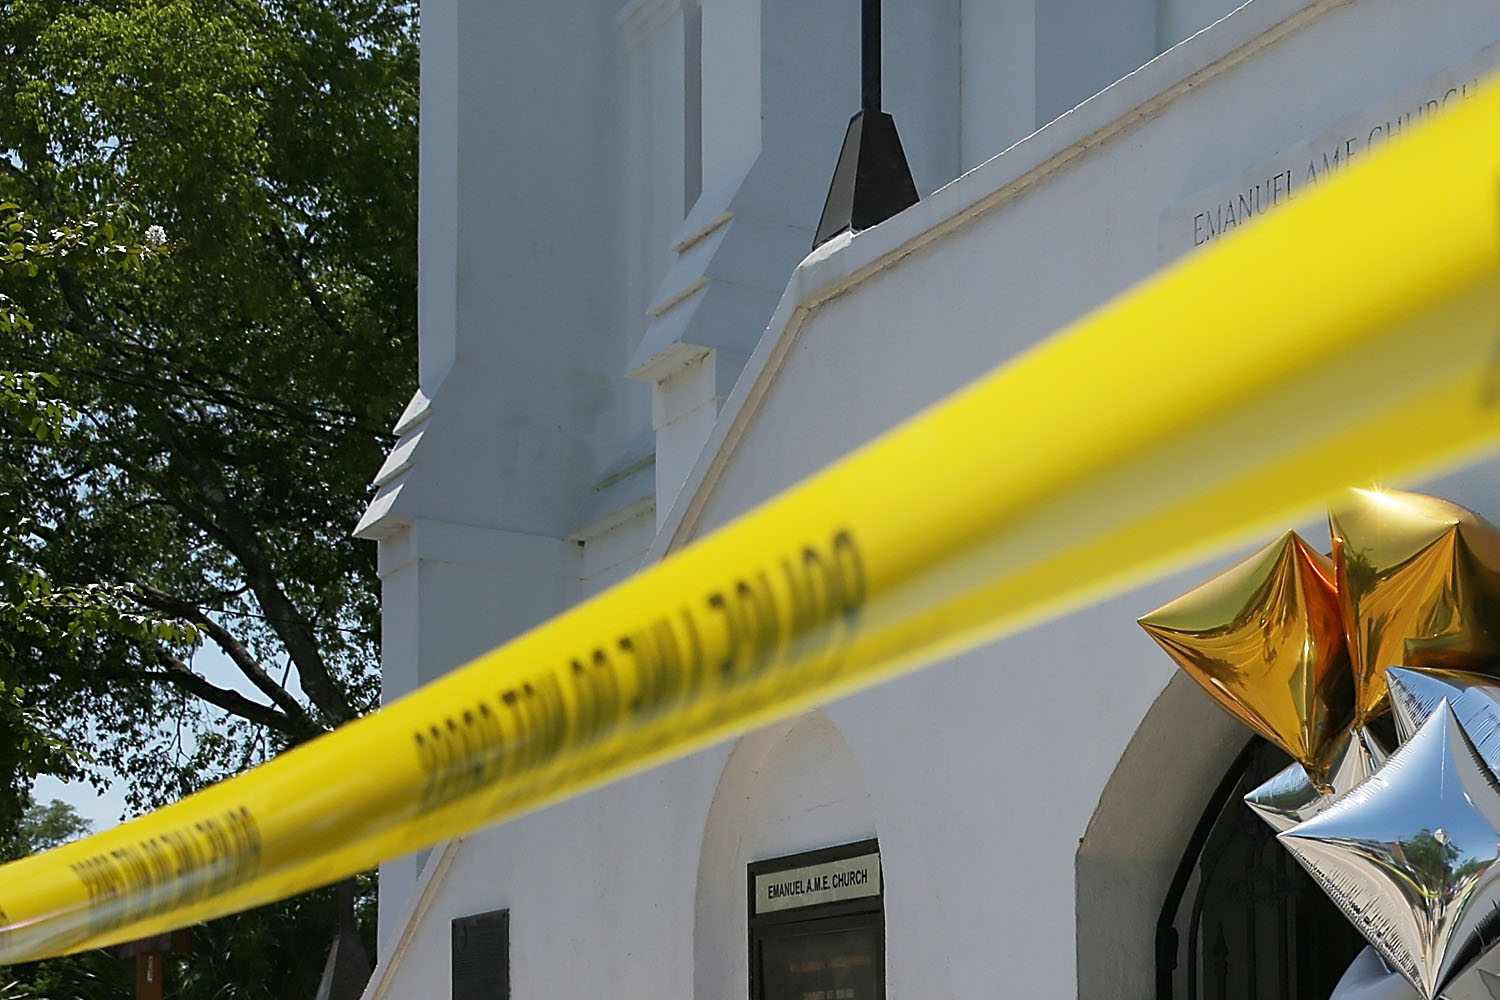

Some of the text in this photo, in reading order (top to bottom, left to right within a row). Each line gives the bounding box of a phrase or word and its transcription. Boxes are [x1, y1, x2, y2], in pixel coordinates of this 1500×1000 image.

[1194, 170, 1295, 247] EMANUEL
[768, 869, 868, 899] EMANUEL A.M.E. CHURCH
